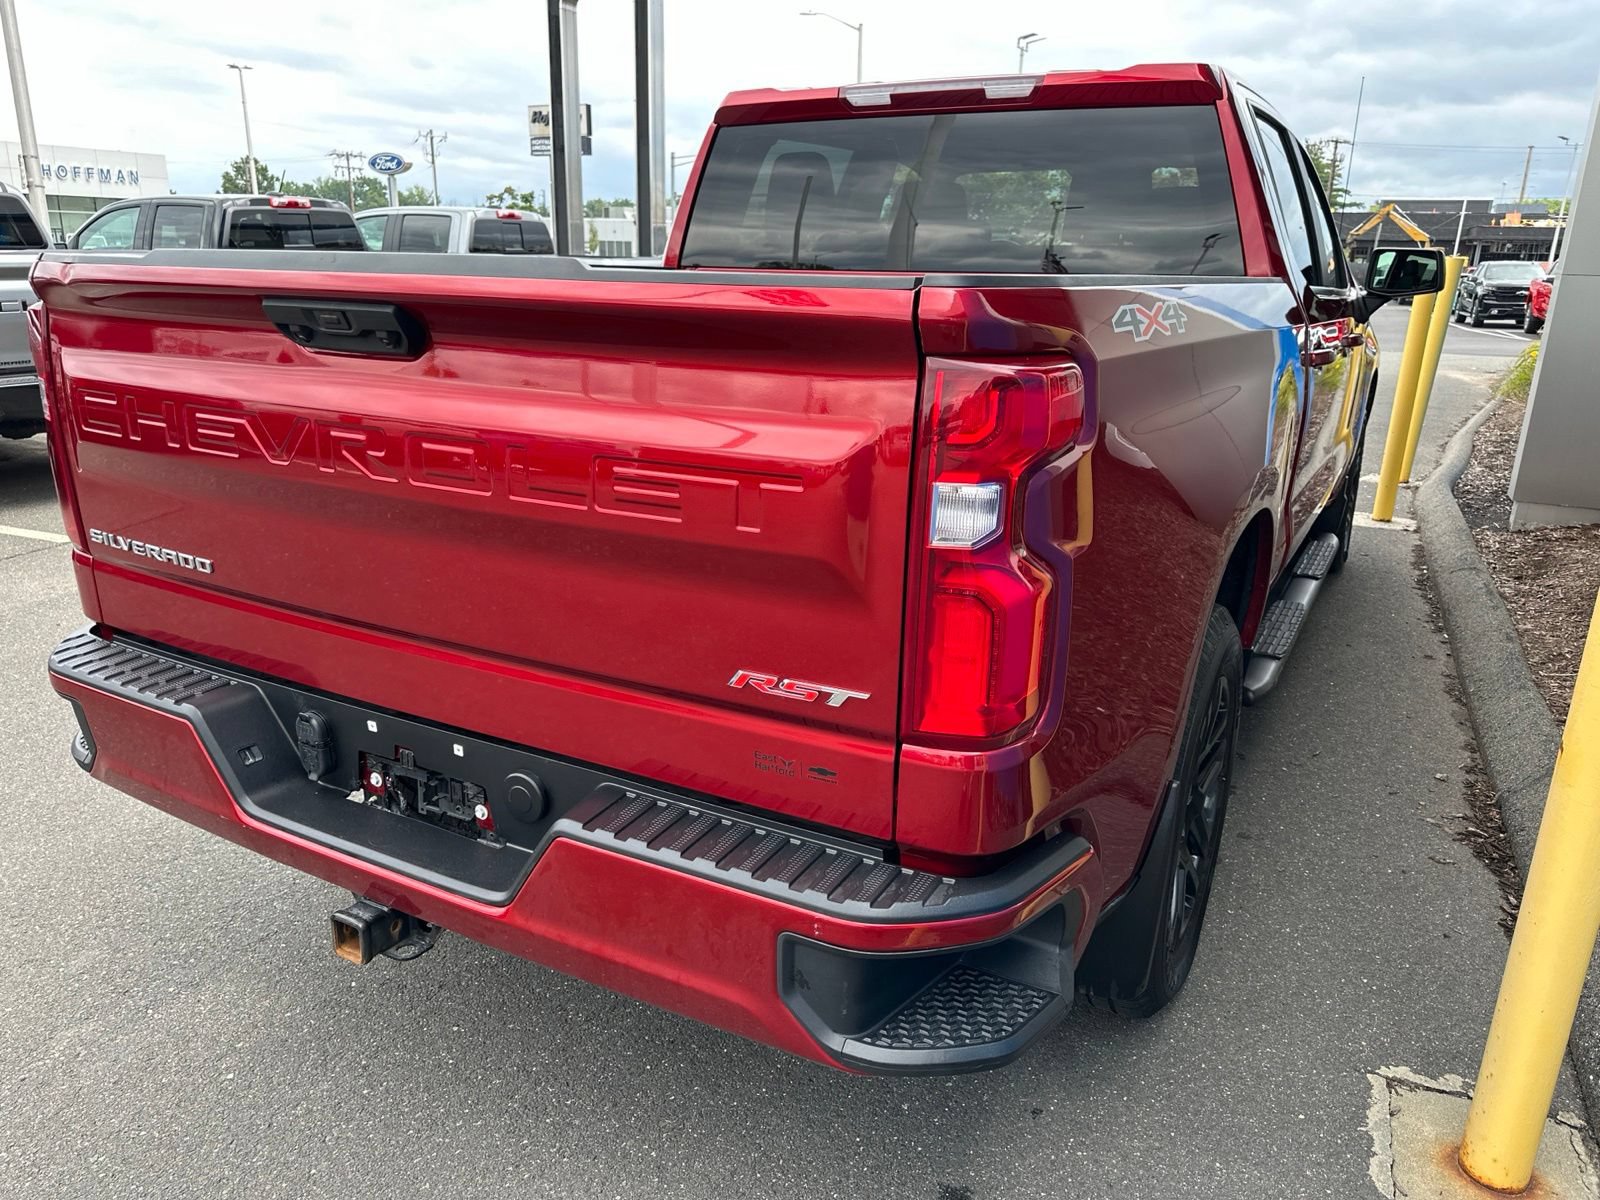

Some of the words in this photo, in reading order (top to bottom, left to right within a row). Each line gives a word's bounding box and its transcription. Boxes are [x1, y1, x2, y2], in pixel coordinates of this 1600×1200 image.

[41, 163, 140, 184] HOFFMAN
[375, 156, 398, 170] Ford
[78, 388, 804, 533] CHEVROLET
[89, 527, 214, 574] SILVERADO
[727, 669, 871, 707] RST
[754, 750, 777, 761] East
